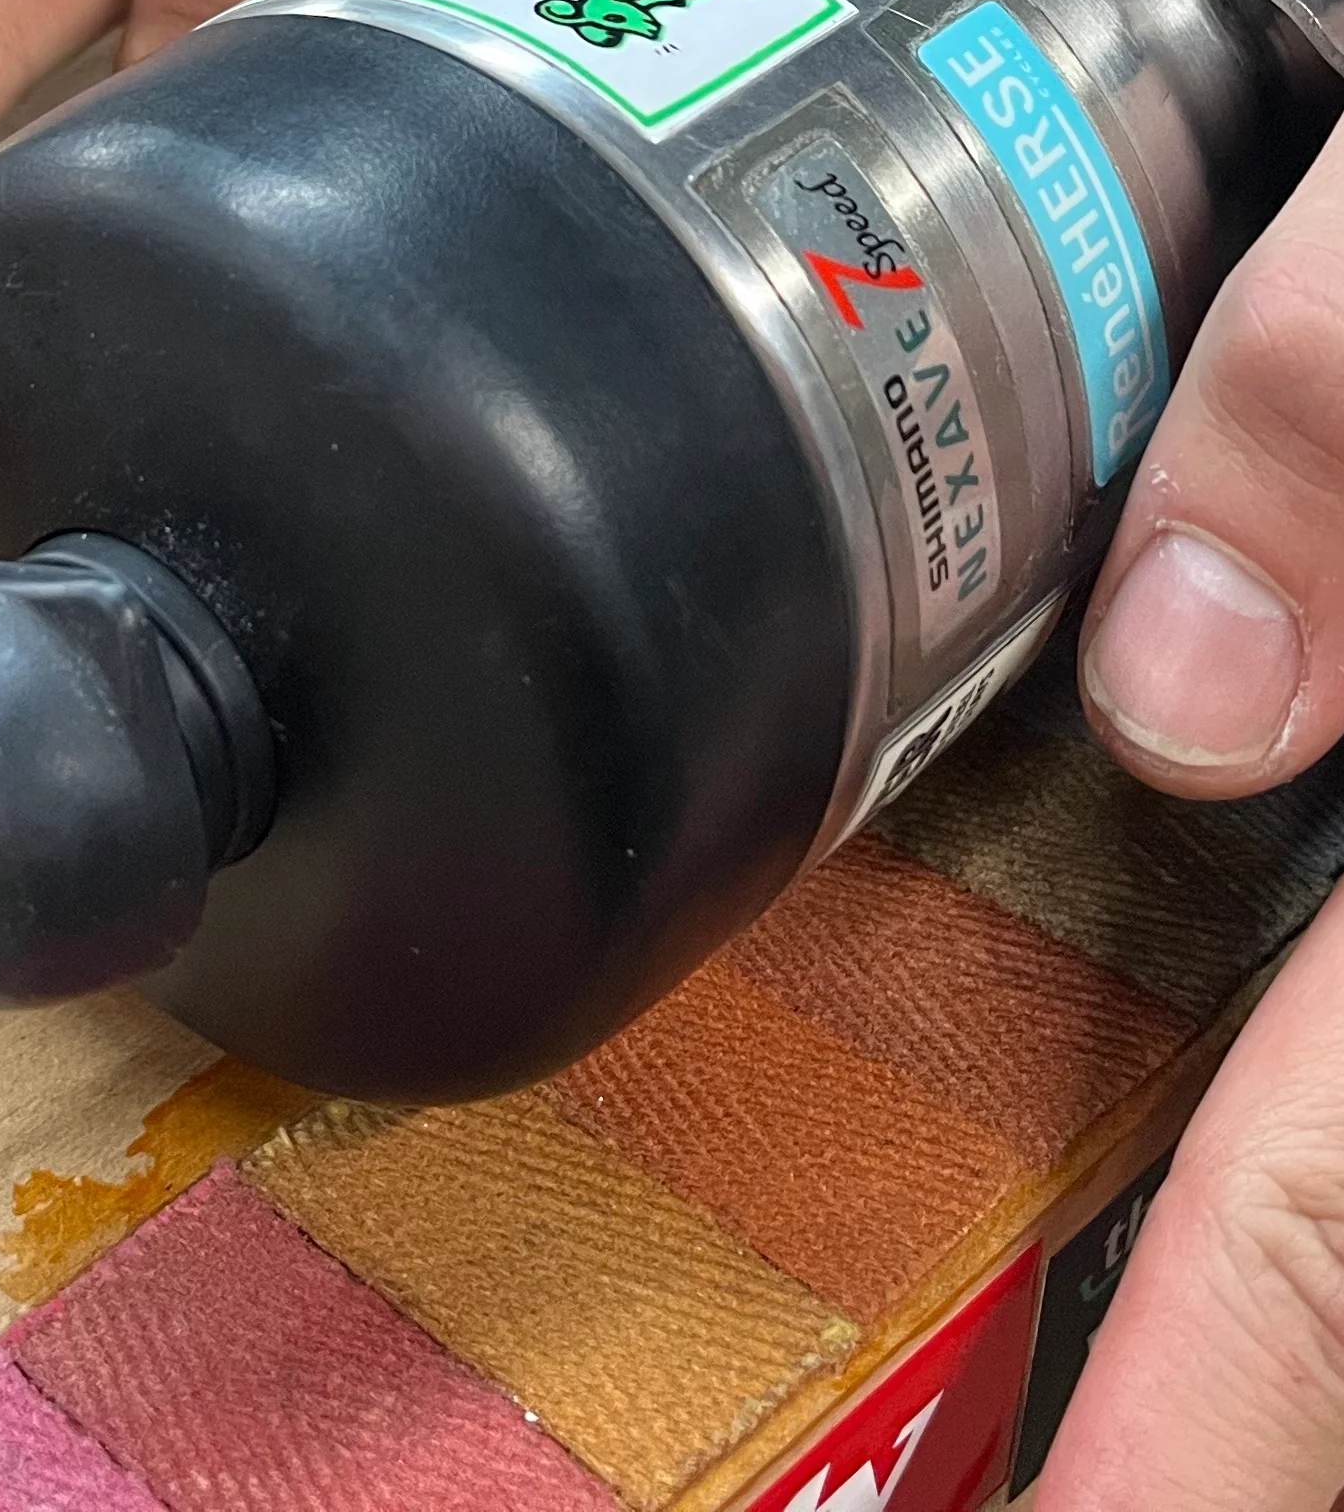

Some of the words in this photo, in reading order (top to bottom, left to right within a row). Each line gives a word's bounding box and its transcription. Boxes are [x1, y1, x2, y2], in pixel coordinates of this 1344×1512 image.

[795, 172, 906, 280] Speed
[882, 373, 950, 592] SHIMANO
[895, 309, 990, 602] NEXAVE
